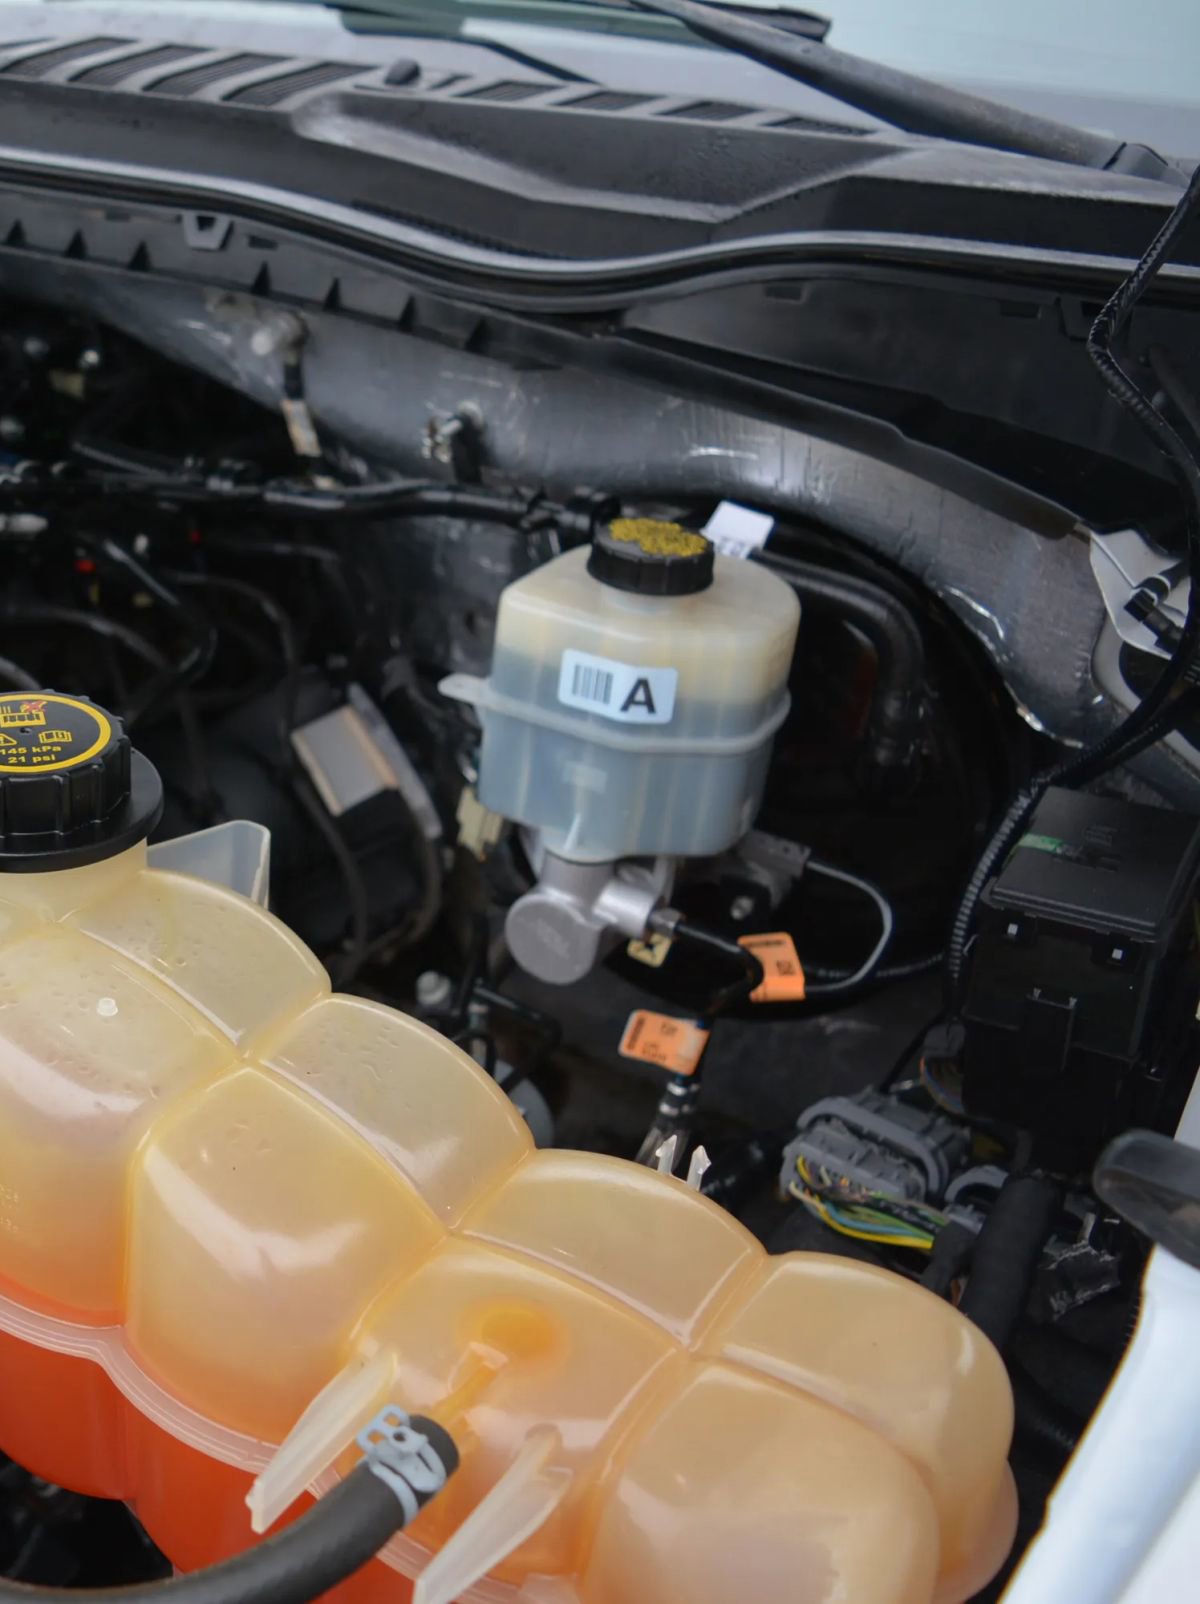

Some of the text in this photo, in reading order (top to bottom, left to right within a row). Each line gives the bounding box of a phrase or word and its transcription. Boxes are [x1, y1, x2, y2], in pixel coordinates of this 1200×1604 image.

[620, 677, 657, 714] A
[31, 745, 62, 753] kPa
[7, 753, 56, 764] 21 psi
